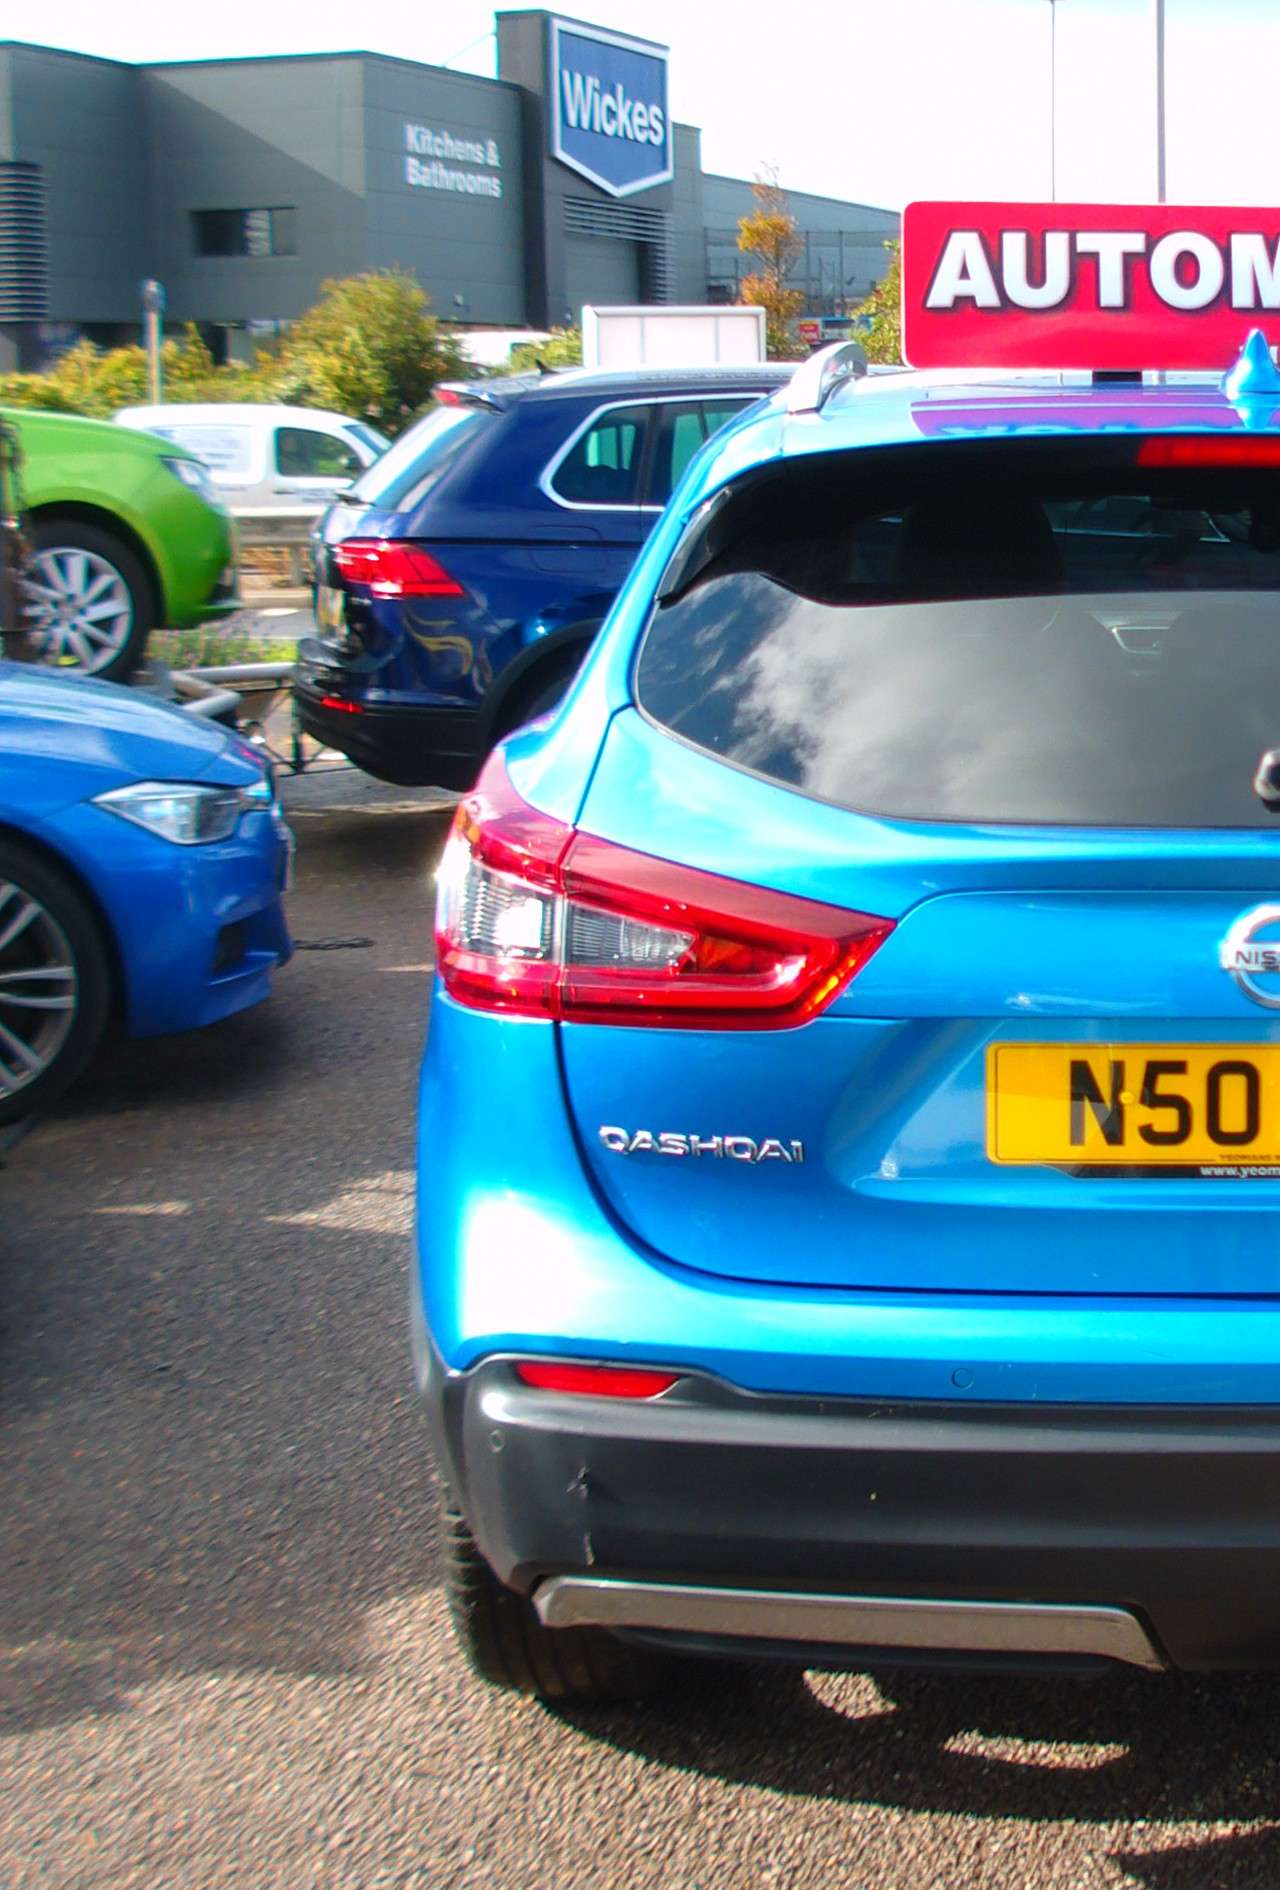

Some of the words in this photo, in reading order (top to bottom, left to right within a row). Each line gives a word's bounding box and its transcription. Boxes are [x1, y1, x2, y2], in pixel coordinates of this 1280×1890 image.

[562, 69, 665, 147] Wickes
[404, 123, 485, 165] Kitchens
[486, 139, 500, 167] &
[405, 155, 501, 198] Bathrooms
[1068, 1060, 1260, 1146] N50
[598, 1125, 804, 1164] QASHQAI
